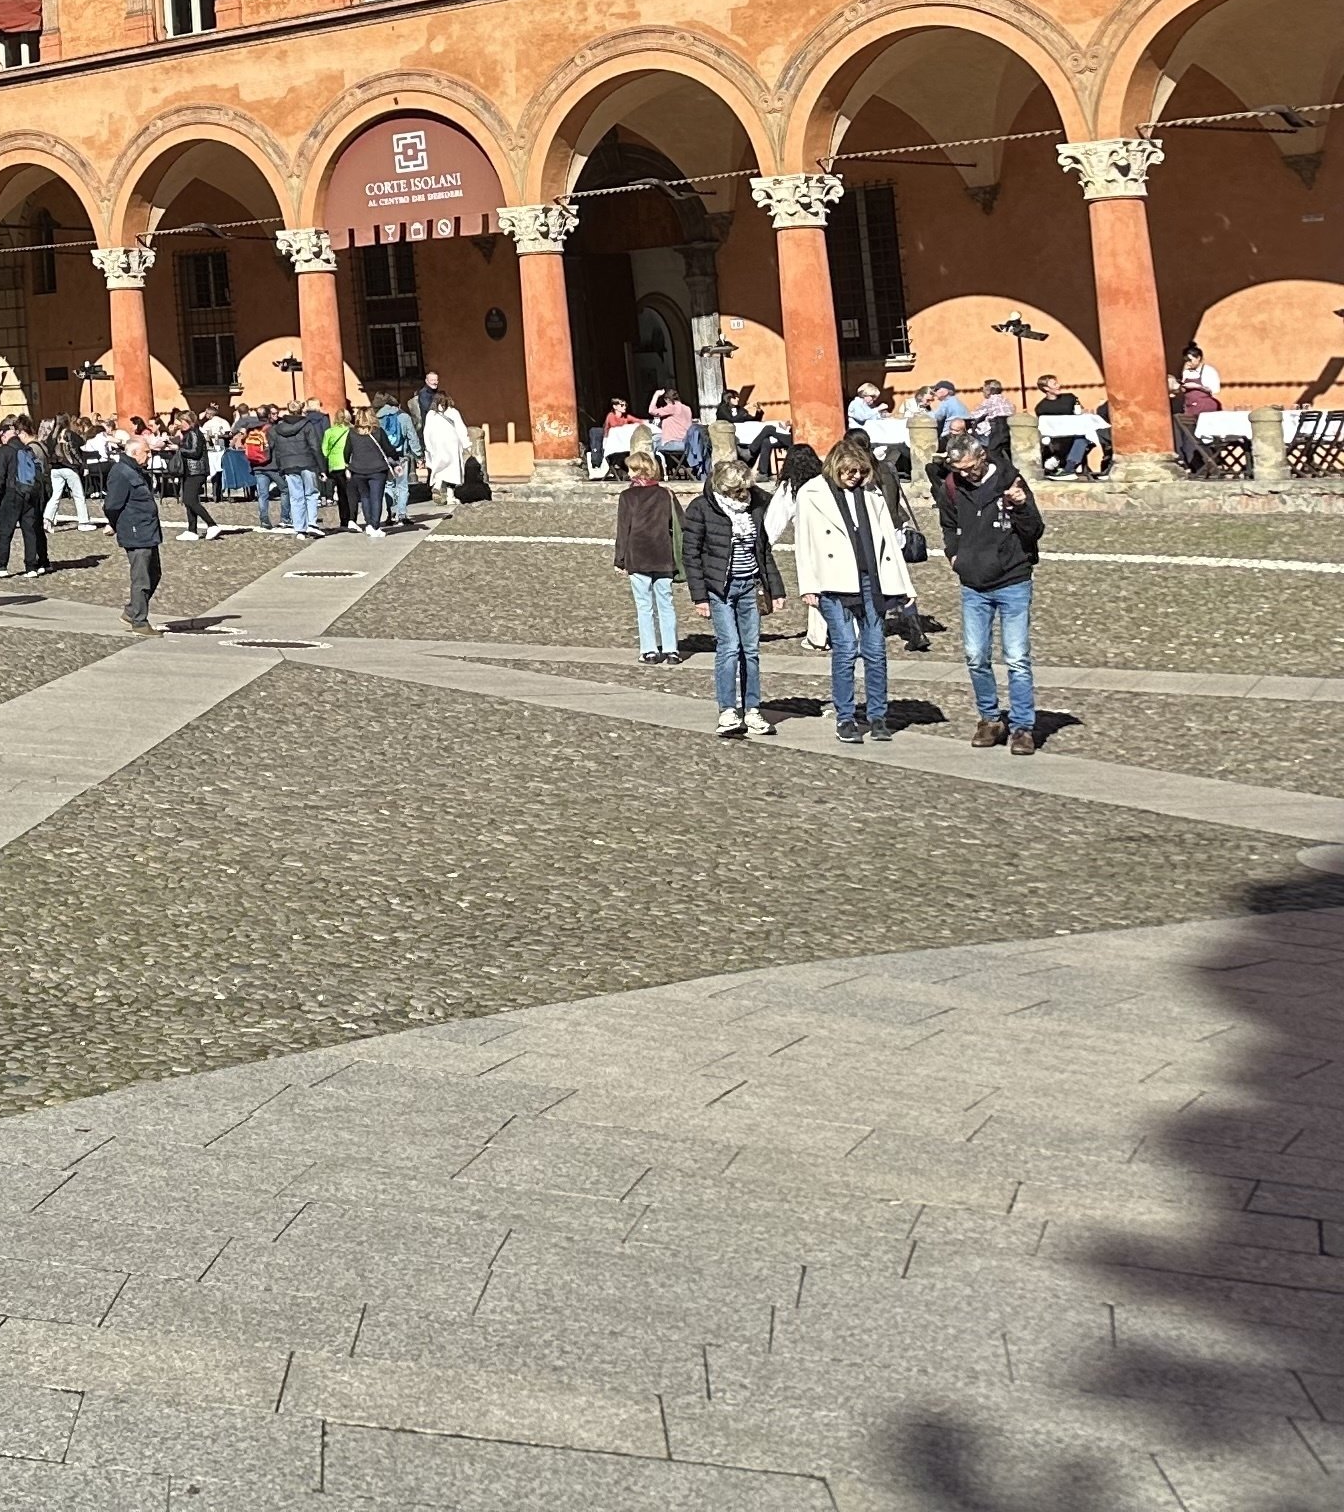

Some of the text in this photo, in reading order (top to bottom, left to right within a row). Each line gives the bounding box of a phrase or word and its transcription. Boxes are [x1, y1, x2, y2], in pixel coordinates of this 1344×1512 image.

[365, 172, 462, 196] CORTE ISOLANI
[368, 199, 378, 207] AL
[379, 195, 410, 206] CENTRO
